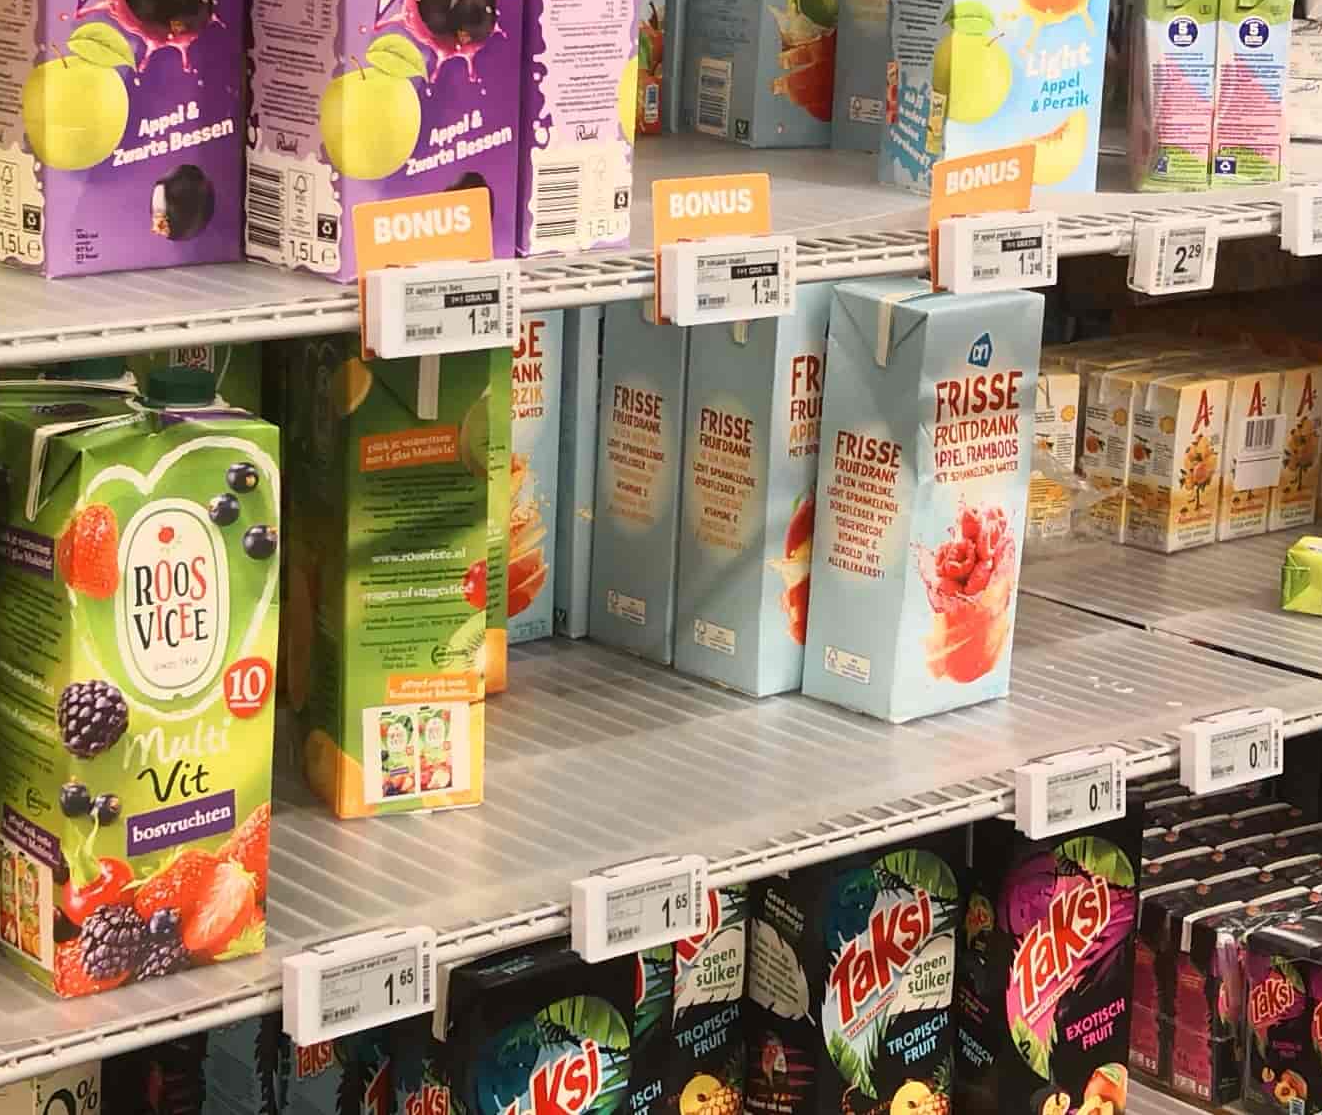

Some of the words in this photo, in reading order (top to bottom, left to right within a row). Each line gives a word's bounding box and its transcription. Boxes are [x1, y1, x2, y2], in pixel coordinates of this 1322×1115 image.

[1024, 40, 1093, 79] Light
[1041, 74, 1081, 97] Appel
[1042, 89, 1090, 113] Perzik
[112, 133, 167, 169] Zwarte
[168, 117, 235, 155] Bessen
[406, 141, 455, 178] Zwarte
[457, 126, 513, 162] Bessen
[945, 158, 1022, 196] BONUS
[669, 188, 754, 219] BONUS
[373, 204, 472, 245] BONUS
[613, 385, 663, 419] FRISSE
[934, 370, 1023, 425] FRISSE
[700, 407, 754, 445] FRISSE
[934, 414, 1020, 448] FRUITDRANK
[699, 432, 751, 460] FRUITDRANK
[836, 430, 903, 469] FRISSE
[966, 439, 1019, 468] FRAMBOOS
[834, 456, 897, 485] FRUITDRANK
[134, 556, 207, 608] ROOS
[133, 600, 209, 651] VICEE
[230, 665, 267, 707] 10
[122, 716, 231, 770] Multi
[137, 761, 211, 803] Vit
[132, 802, 231, 844] bosvruchten
[695, 962, 743, 988] suiker
[702, 946, 737, 971] geen
[913, 952, 948, 977] geen
[907, 968, 952, 995] suiker
[677, 1003, 741, 1047] TROPISCH
[887, 1011, 950, 1056] TROPISCH
[1065, 997, 1127, 1043] EXOTISCH
[1082, 1021, 1115, 1051] FRUIT
[693, 1028, 728, 1059] FRUIT
[903, 1036, 939, 1067] FRUIT
